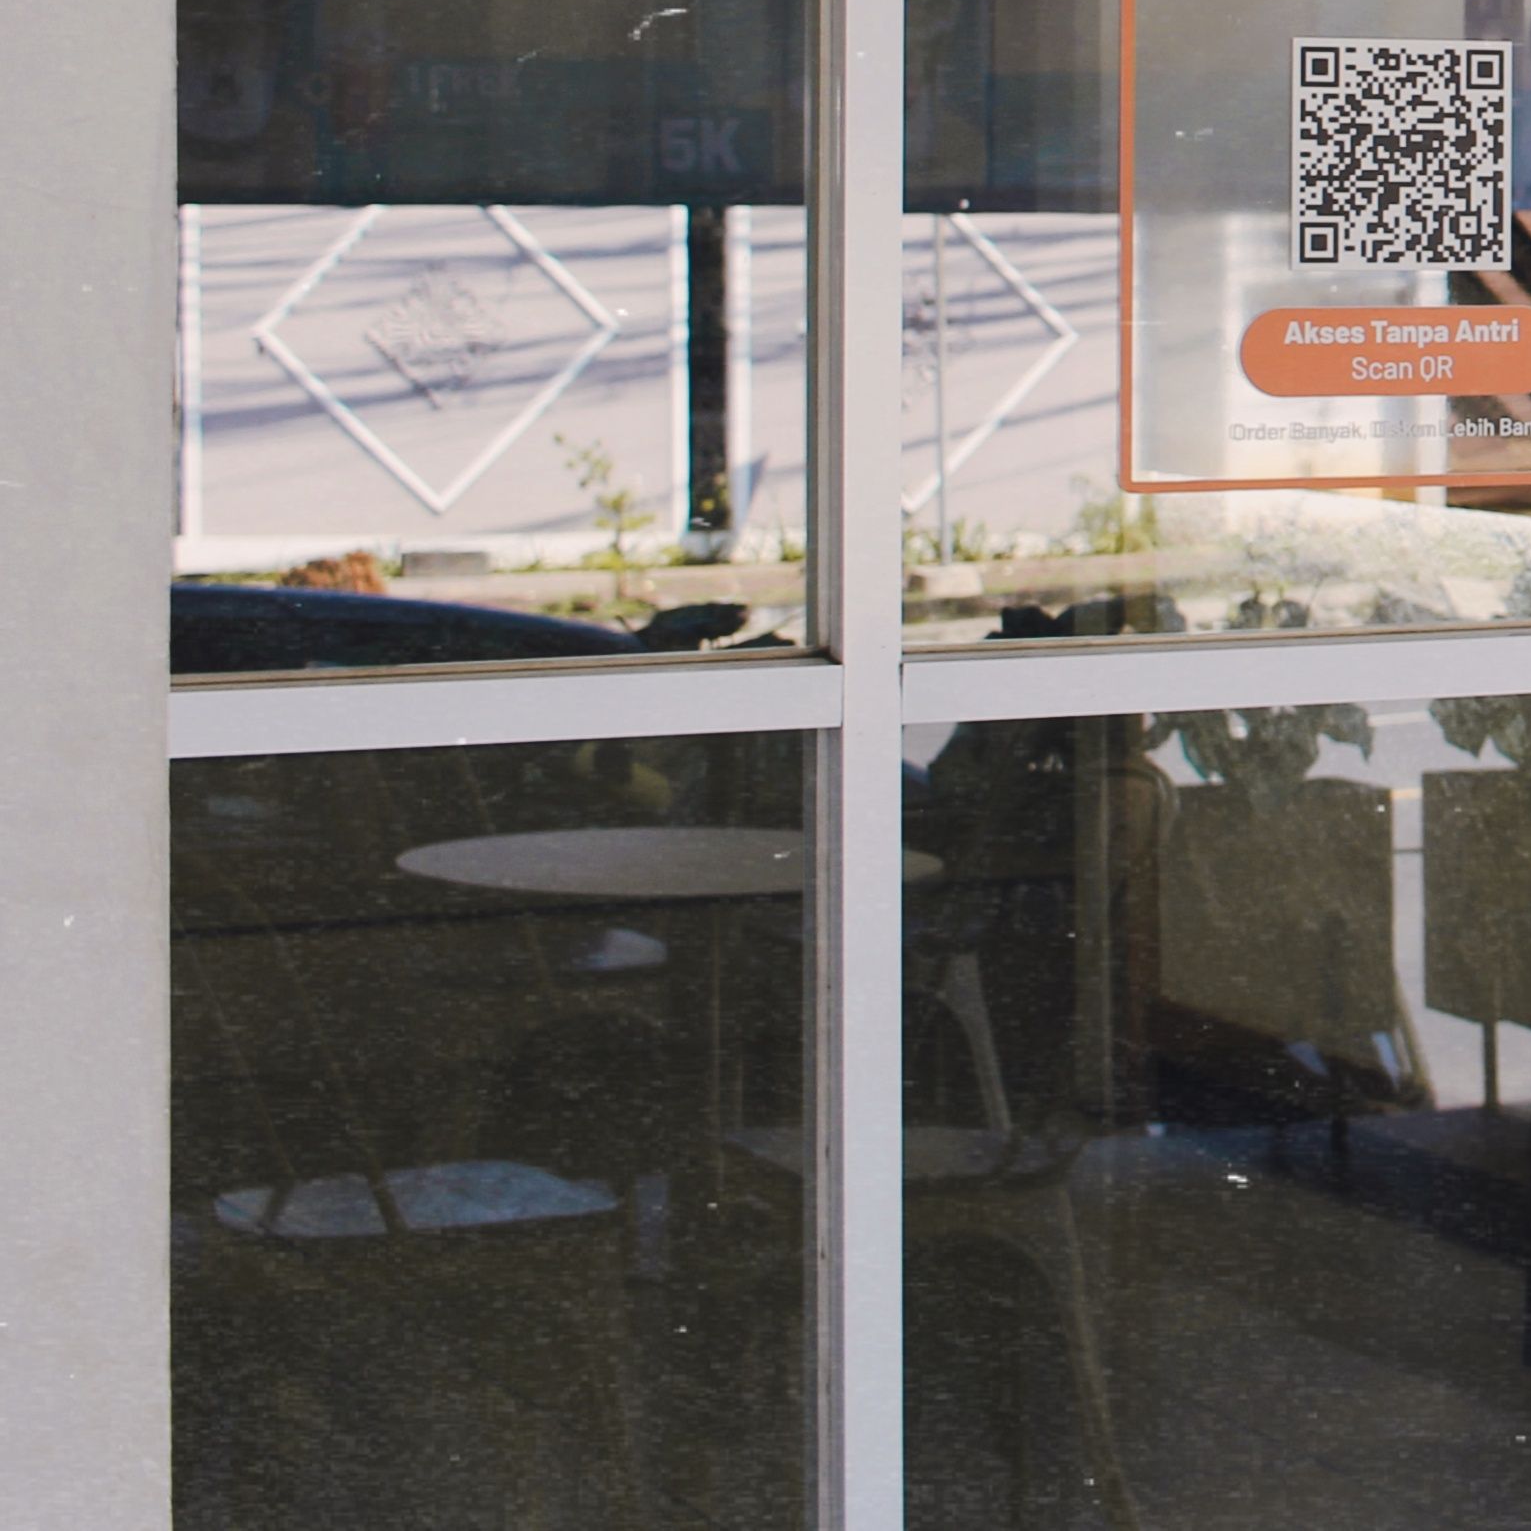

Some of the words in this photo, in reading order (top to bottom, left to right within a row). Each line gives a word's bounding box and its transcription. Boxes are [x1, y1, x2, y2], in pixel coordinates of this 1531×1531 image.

[659, 117, 742, 173] 5K
[1283, 319, 1364, 347] Akses
[1369, 319, 1451, 348] Tanpa
[1455, 318, 1519, 344] Antri
[1350, 355, 1415, 381] Scan
[1419, 355, 1453, 382] QR
[1229, 422, 1287, 442] Order
[1440, 419, 1495, 438] Lebih
